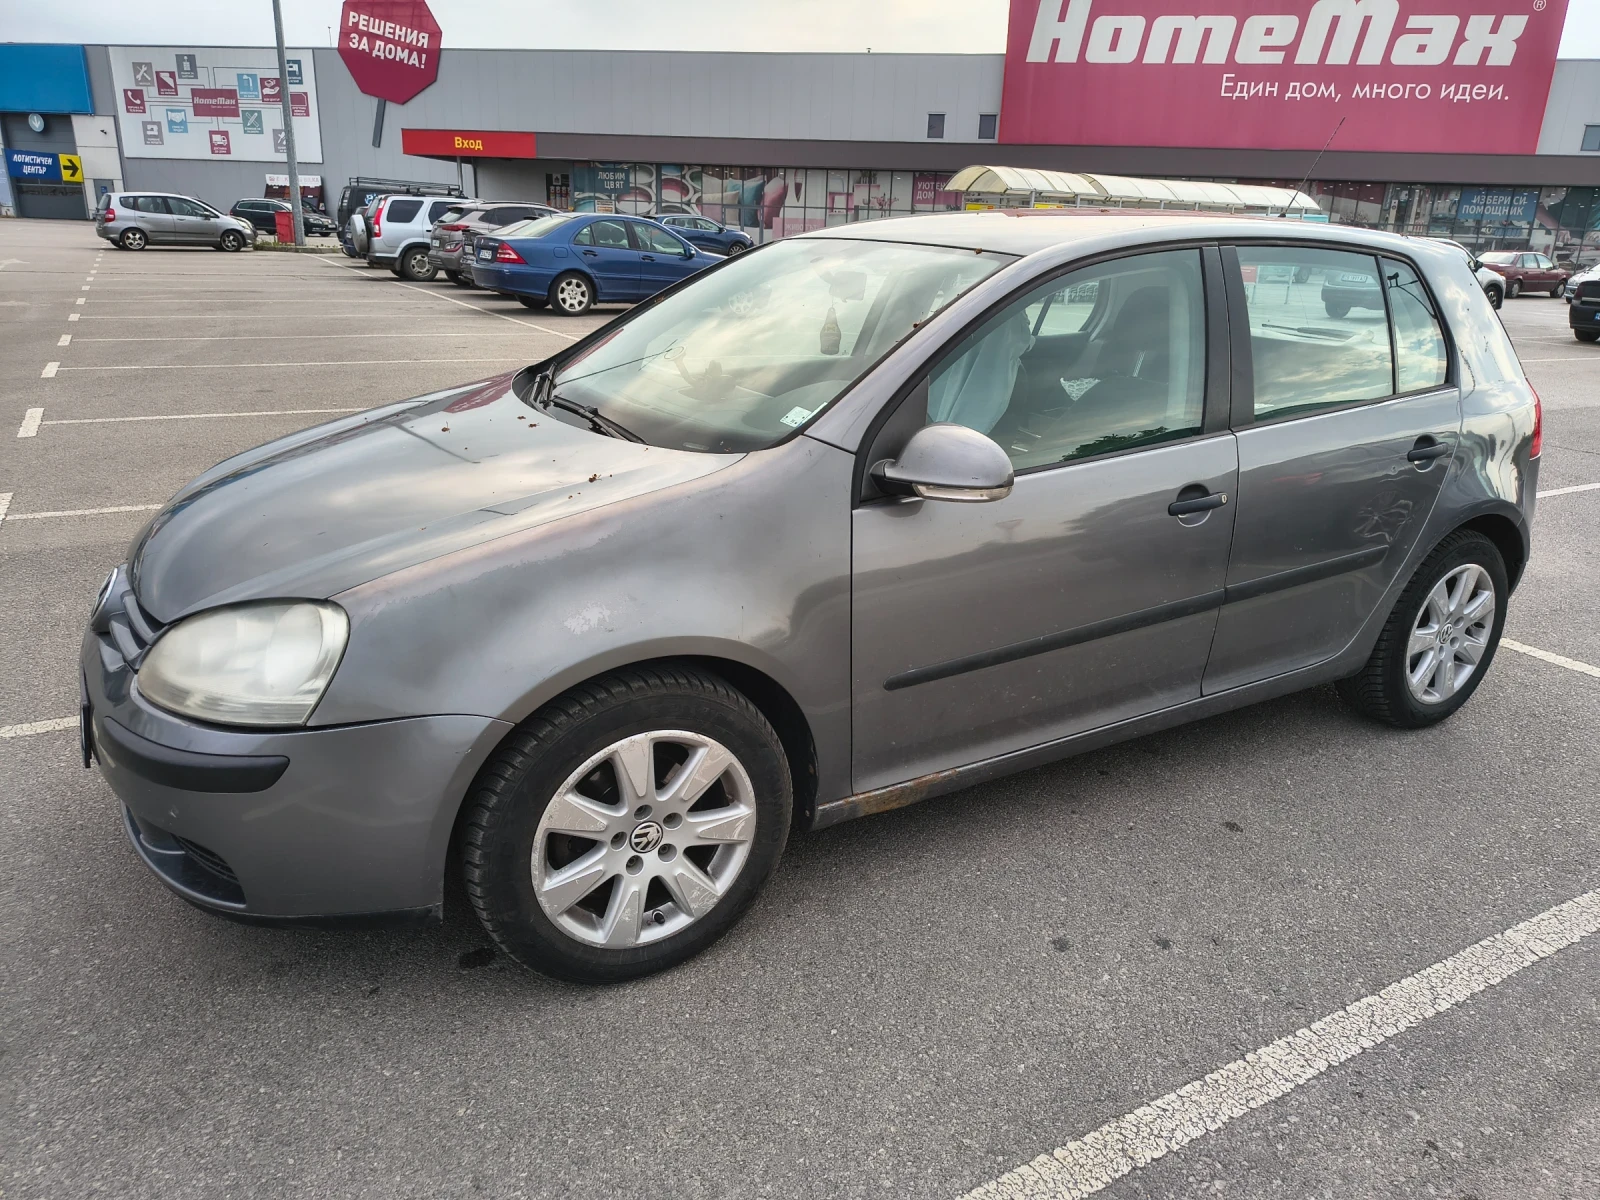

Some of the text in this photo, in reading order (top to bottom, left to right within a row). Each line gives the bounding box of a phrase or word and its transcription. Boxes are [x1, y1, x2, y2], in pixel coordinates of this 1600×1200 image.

[348, 11, 430, 49] РЕШЕНИЯ
[1026, 0, 1529, 66] HomeMax
[349, 33, 427, 69] ЗА ДОМА!
[1220, 73, 1510, 103] Един дом, много идеи.
[193, 96, 237, 105] HomeMax
[454, 136, 483, 151] Вход
[23, 164, 47, 175] ЦЕНТЪР
[598, 171, 626, 180] ЛЮБИМ
[604, 180, 625, 190] ЦВЯТ
[916, 190, 935, 200] ДОМ
[1473, 195, 1527, 205] ИЗБЕРИ СИ
[1462, 204, 1525, 216] ПОМОЩНИК
